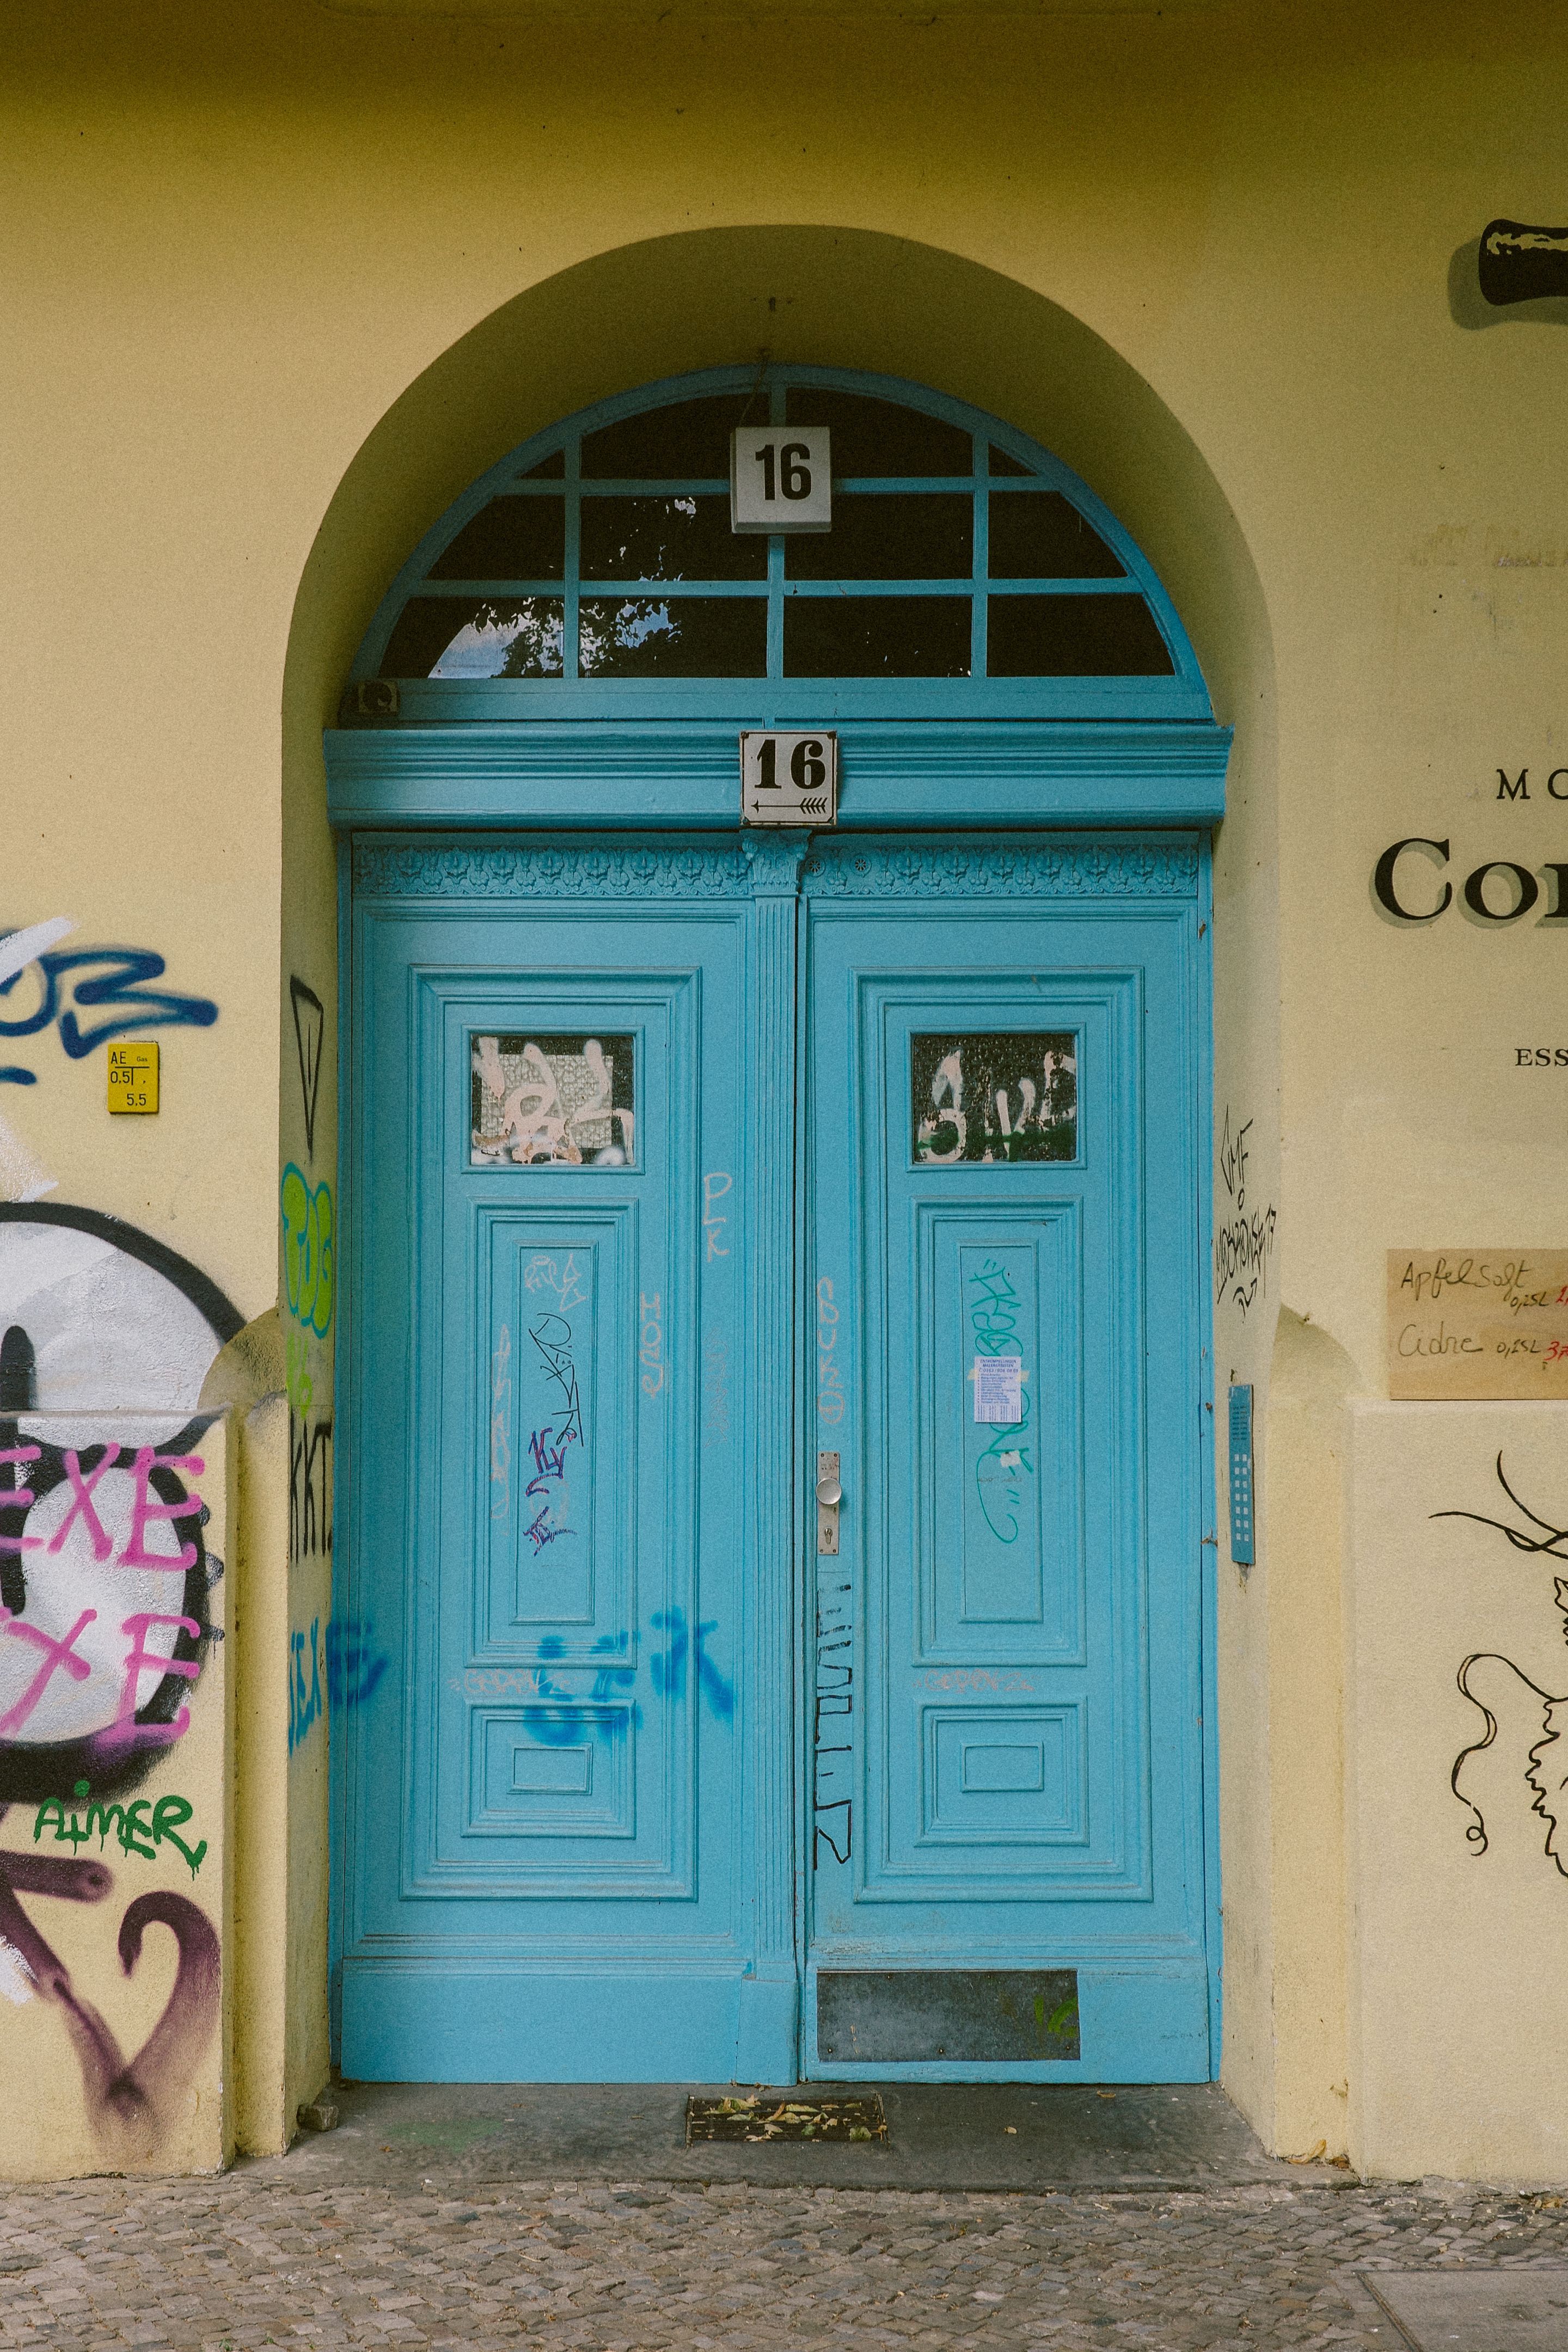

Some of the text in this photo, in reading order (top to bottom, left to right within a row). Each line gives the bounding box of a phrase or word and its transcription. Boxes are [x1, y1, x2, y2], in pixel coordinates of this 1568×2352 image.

[755, 443, 812, 501] 16
[754, 739, 826, 790] 16
[111, 1051, 127, 1064] AE
[110, 1071, 130, 1084] 0,5
[126, 1093, 147, 1106] 5,5
